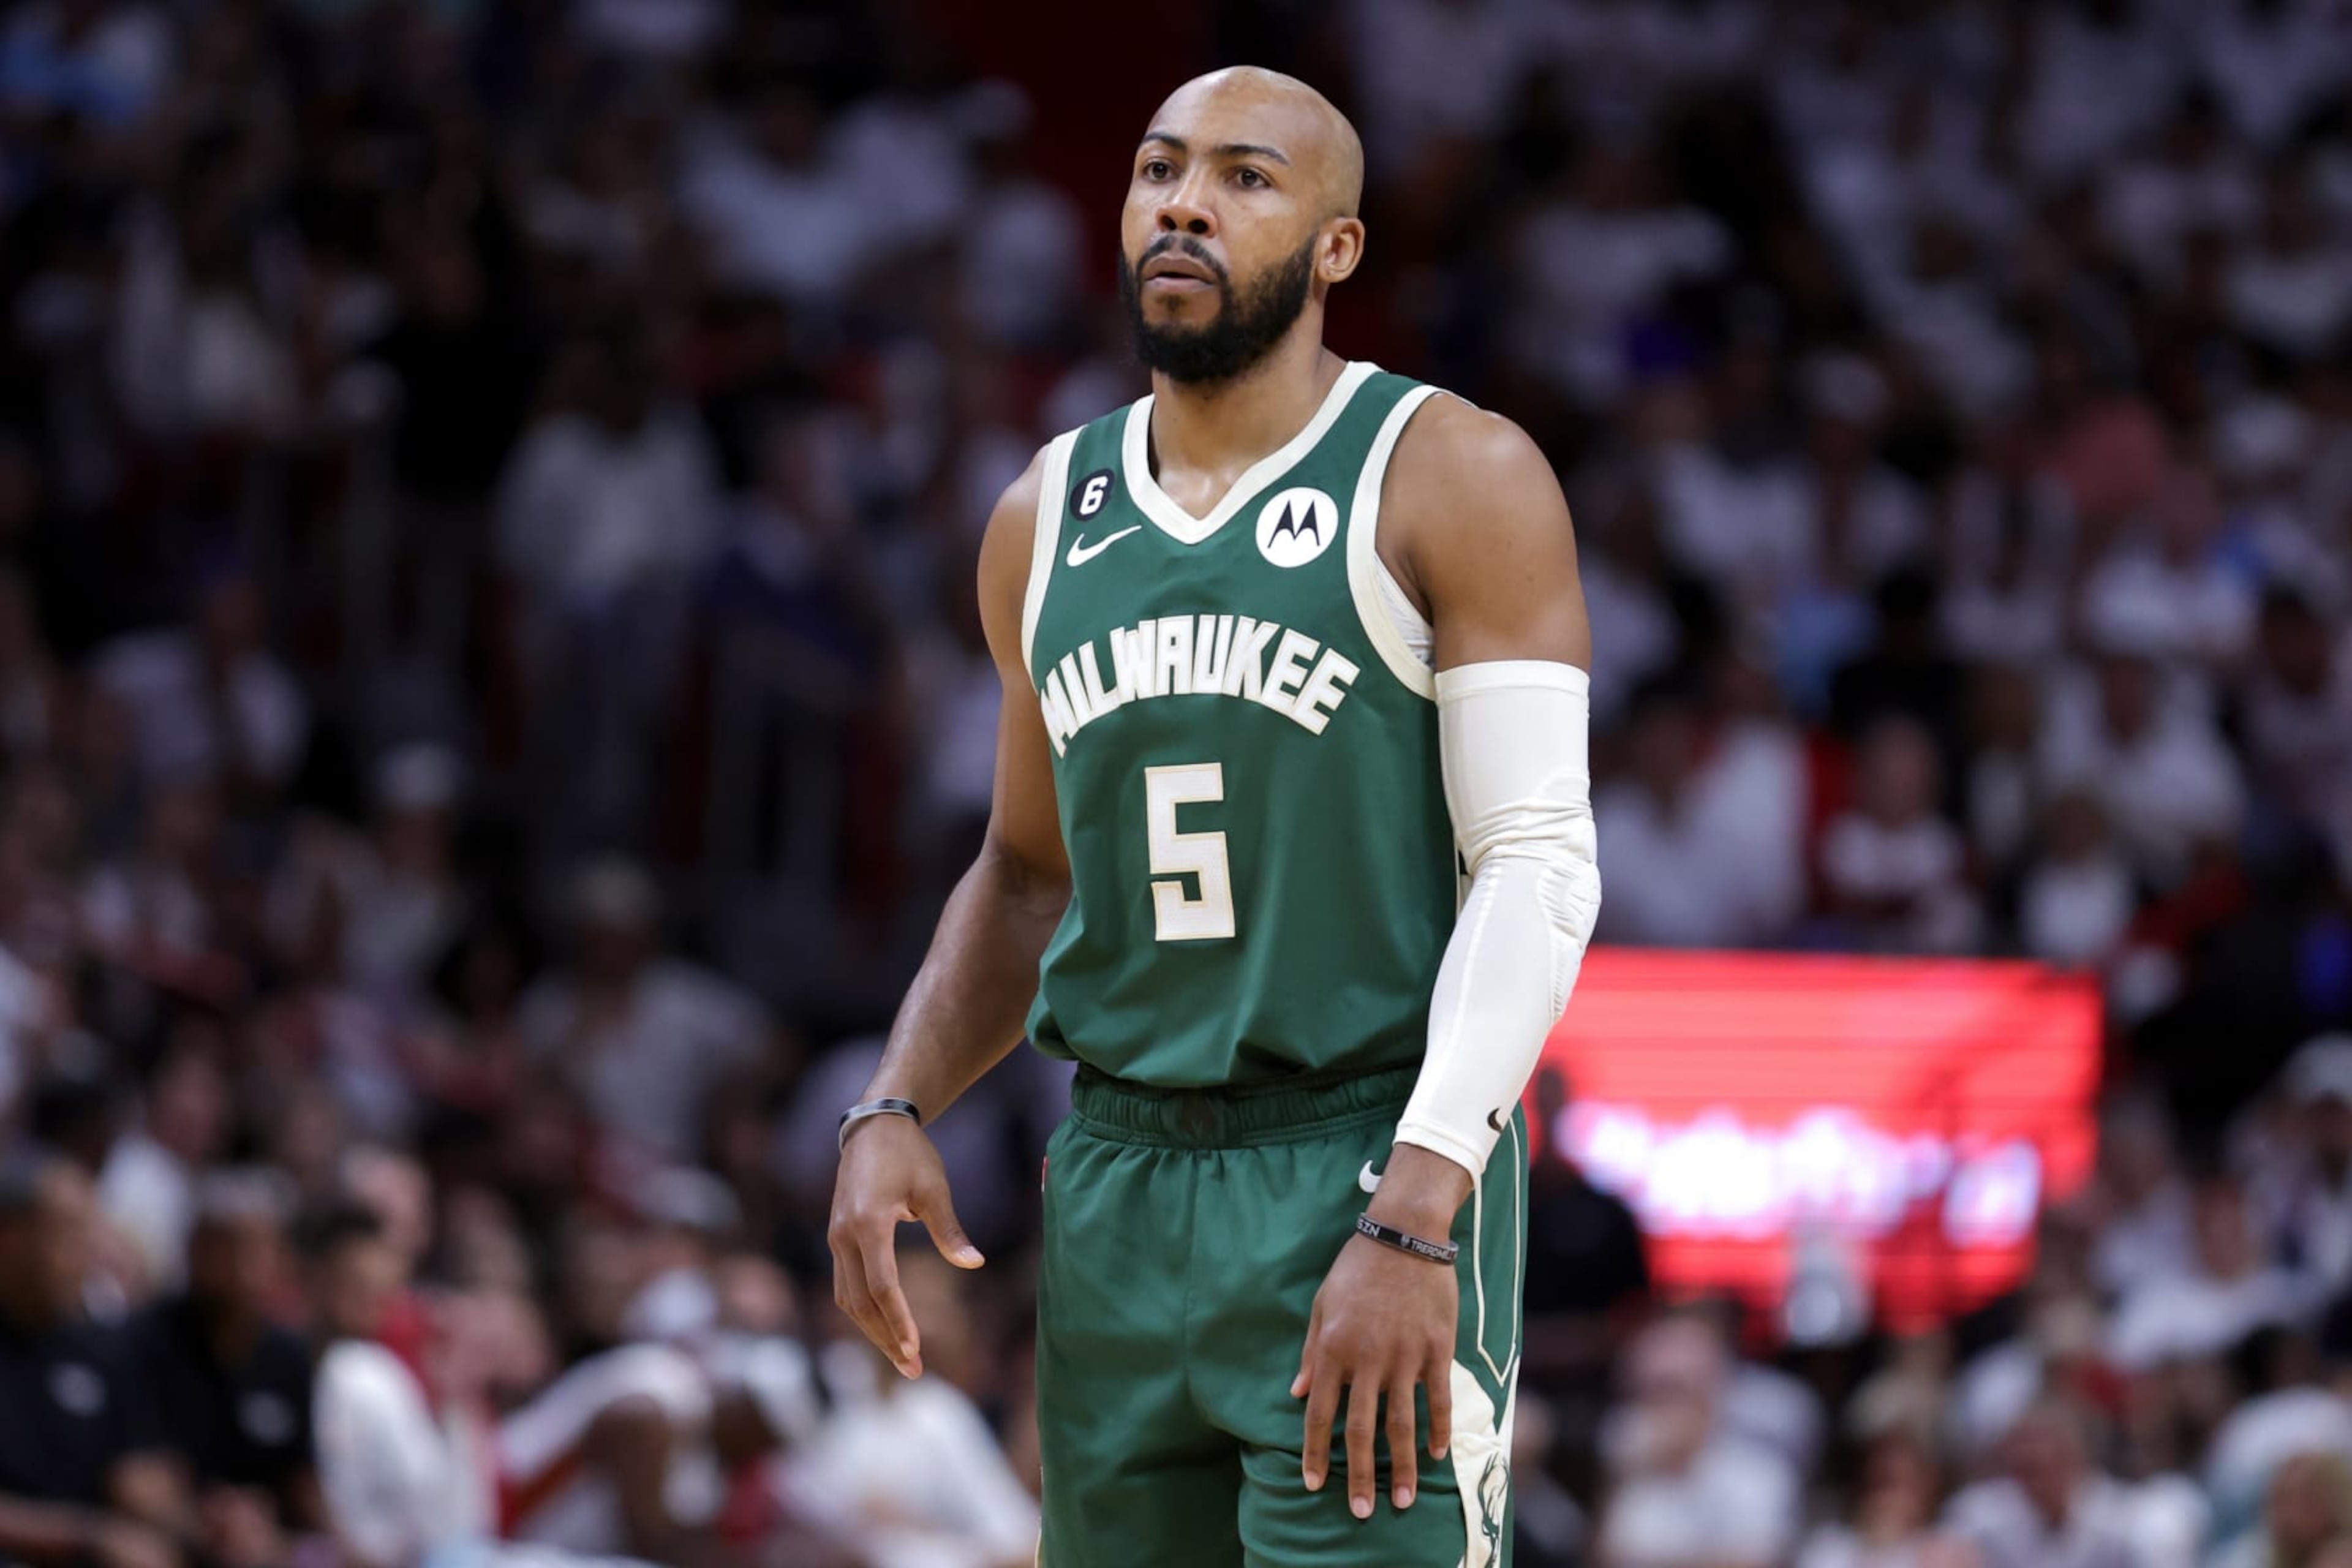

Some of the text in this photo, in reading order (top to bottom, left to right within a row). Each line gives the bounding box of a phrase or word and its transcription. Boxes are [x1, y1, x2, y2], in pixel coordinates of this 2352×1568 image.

[1079, 476, 1109, 516] 6
[1041, 614, 1360, 760] MILWAUKEE
[1144, 762, 1235, 942] 5
